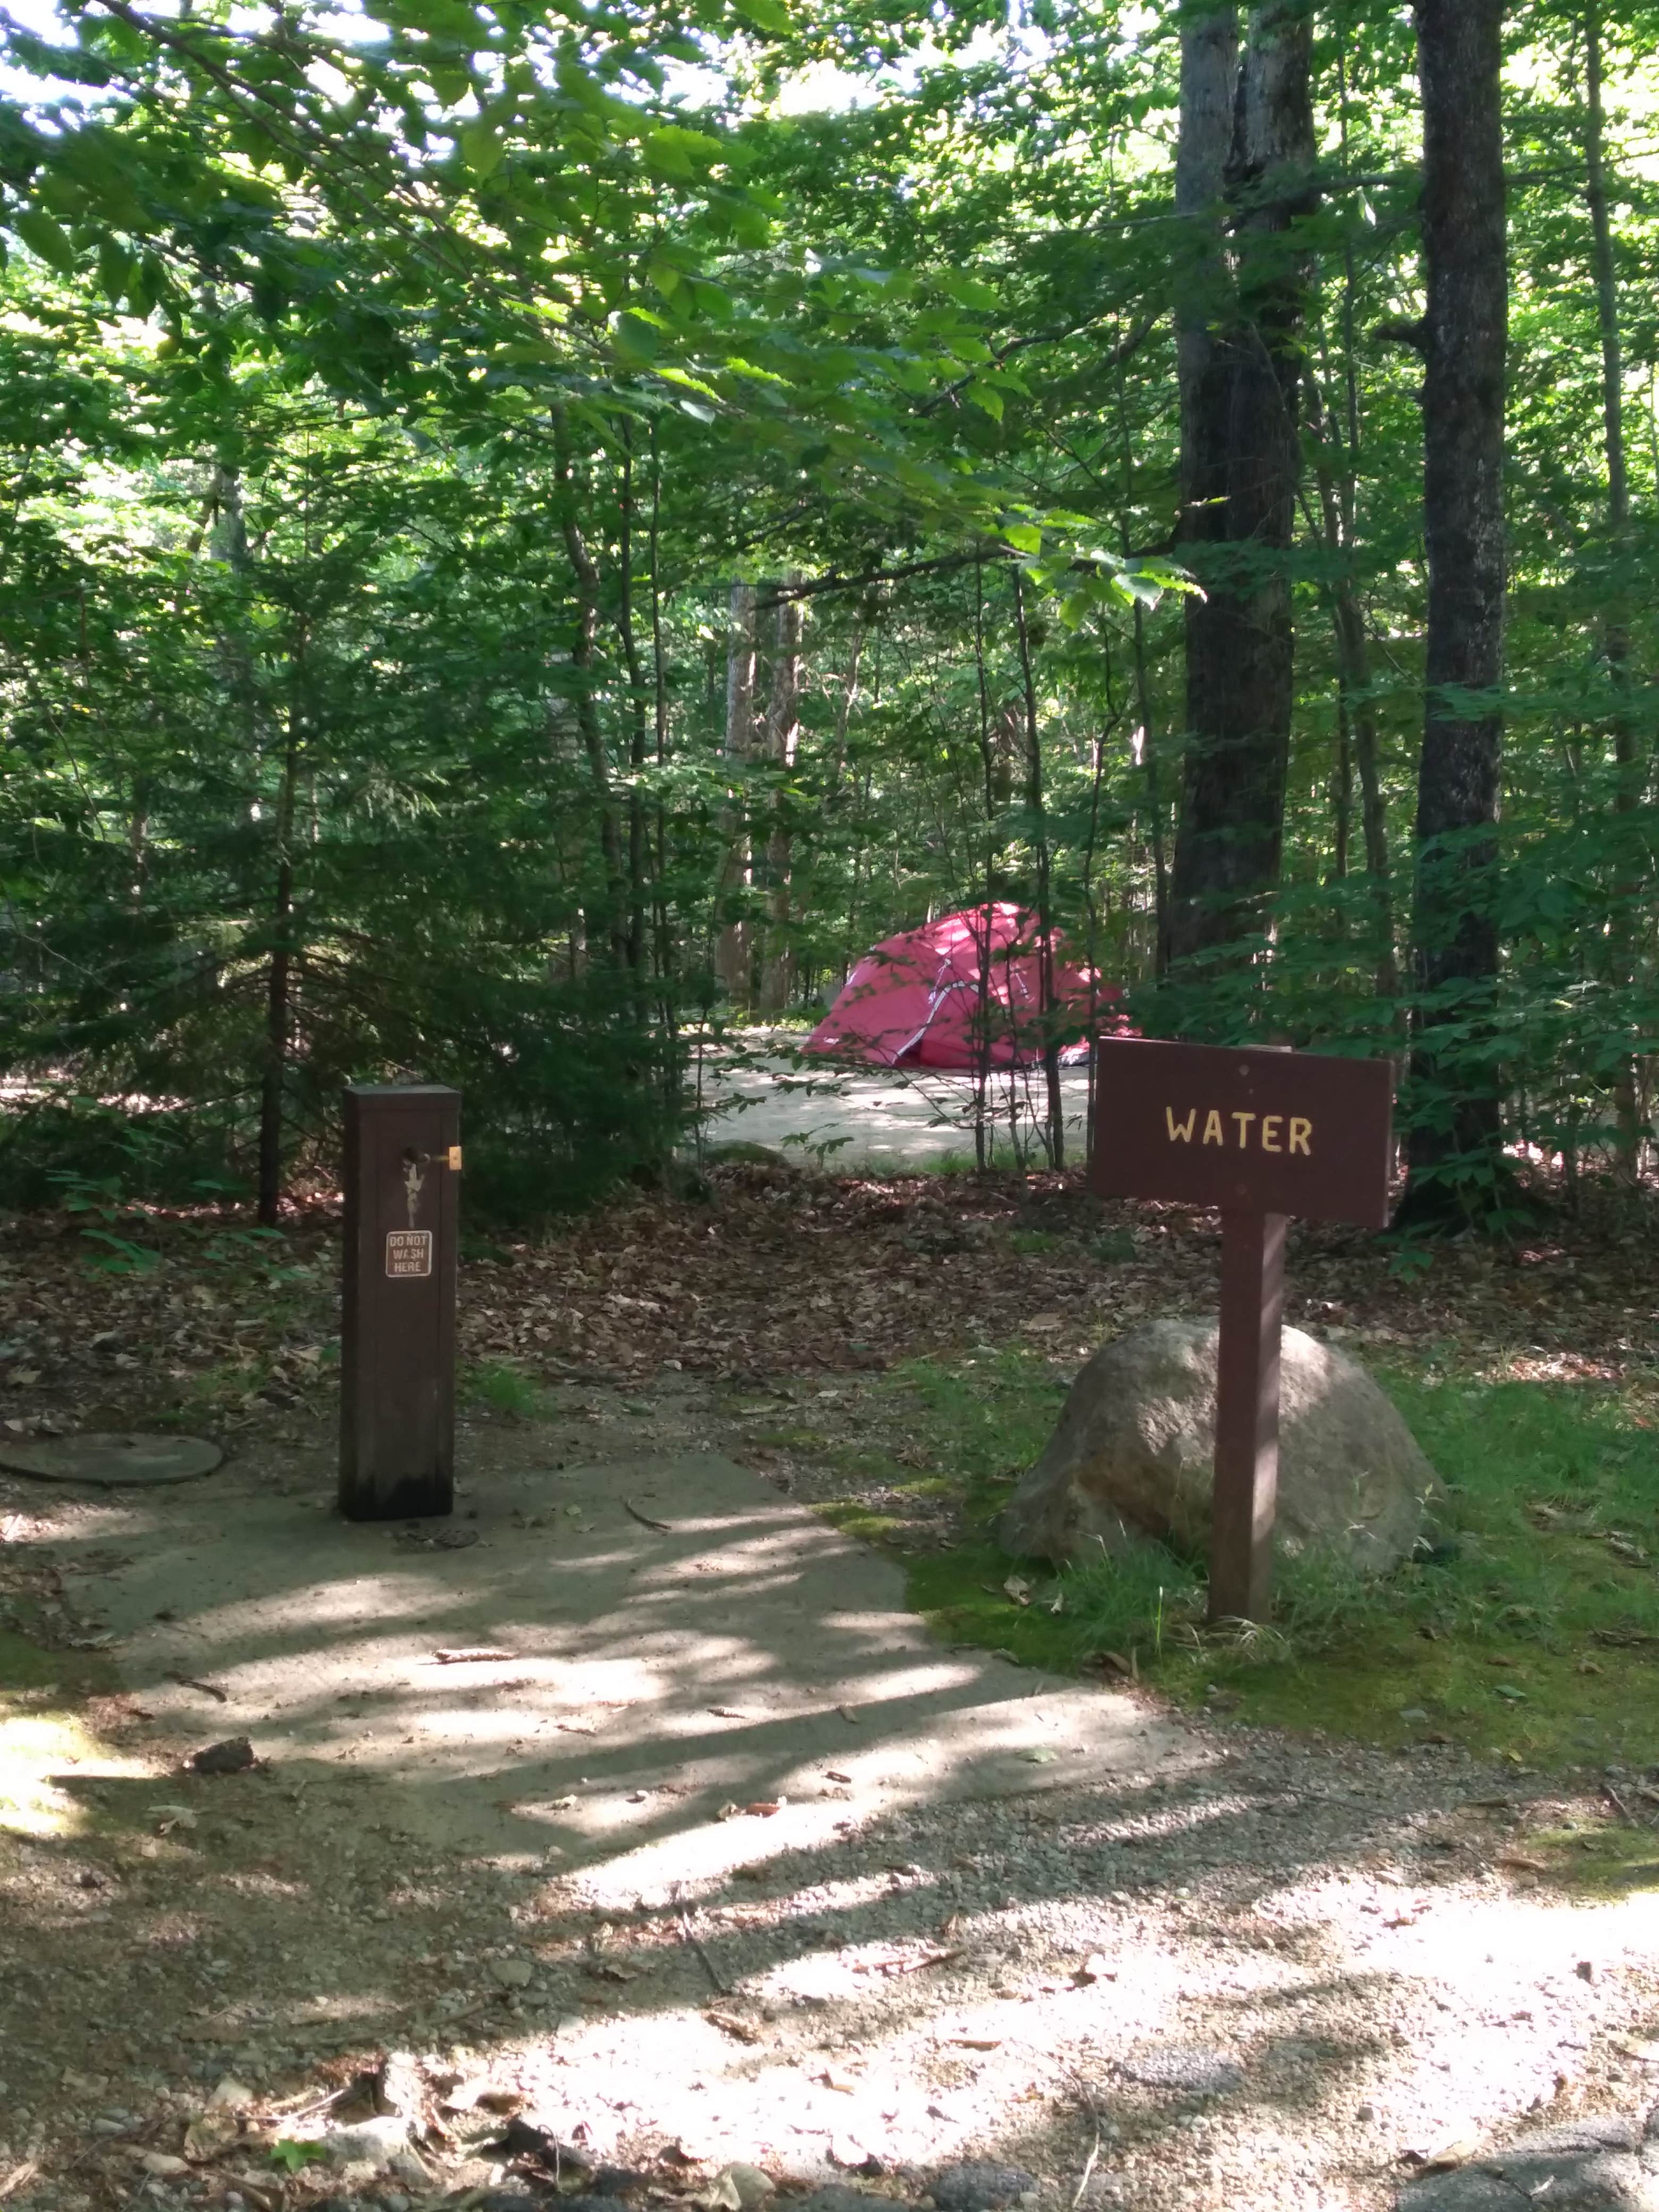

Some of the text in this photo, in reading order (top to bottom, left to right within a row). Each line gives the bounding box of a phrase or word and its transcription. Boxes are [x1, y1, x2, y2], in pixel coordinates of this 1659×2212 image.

[1166, 1106, 1312, 1155] WATER
[390, 1235, 427, 1246] DO NOT
[393, 1248, 424, 1260] WASH
[394, 1261, 422, 1272] HERE
